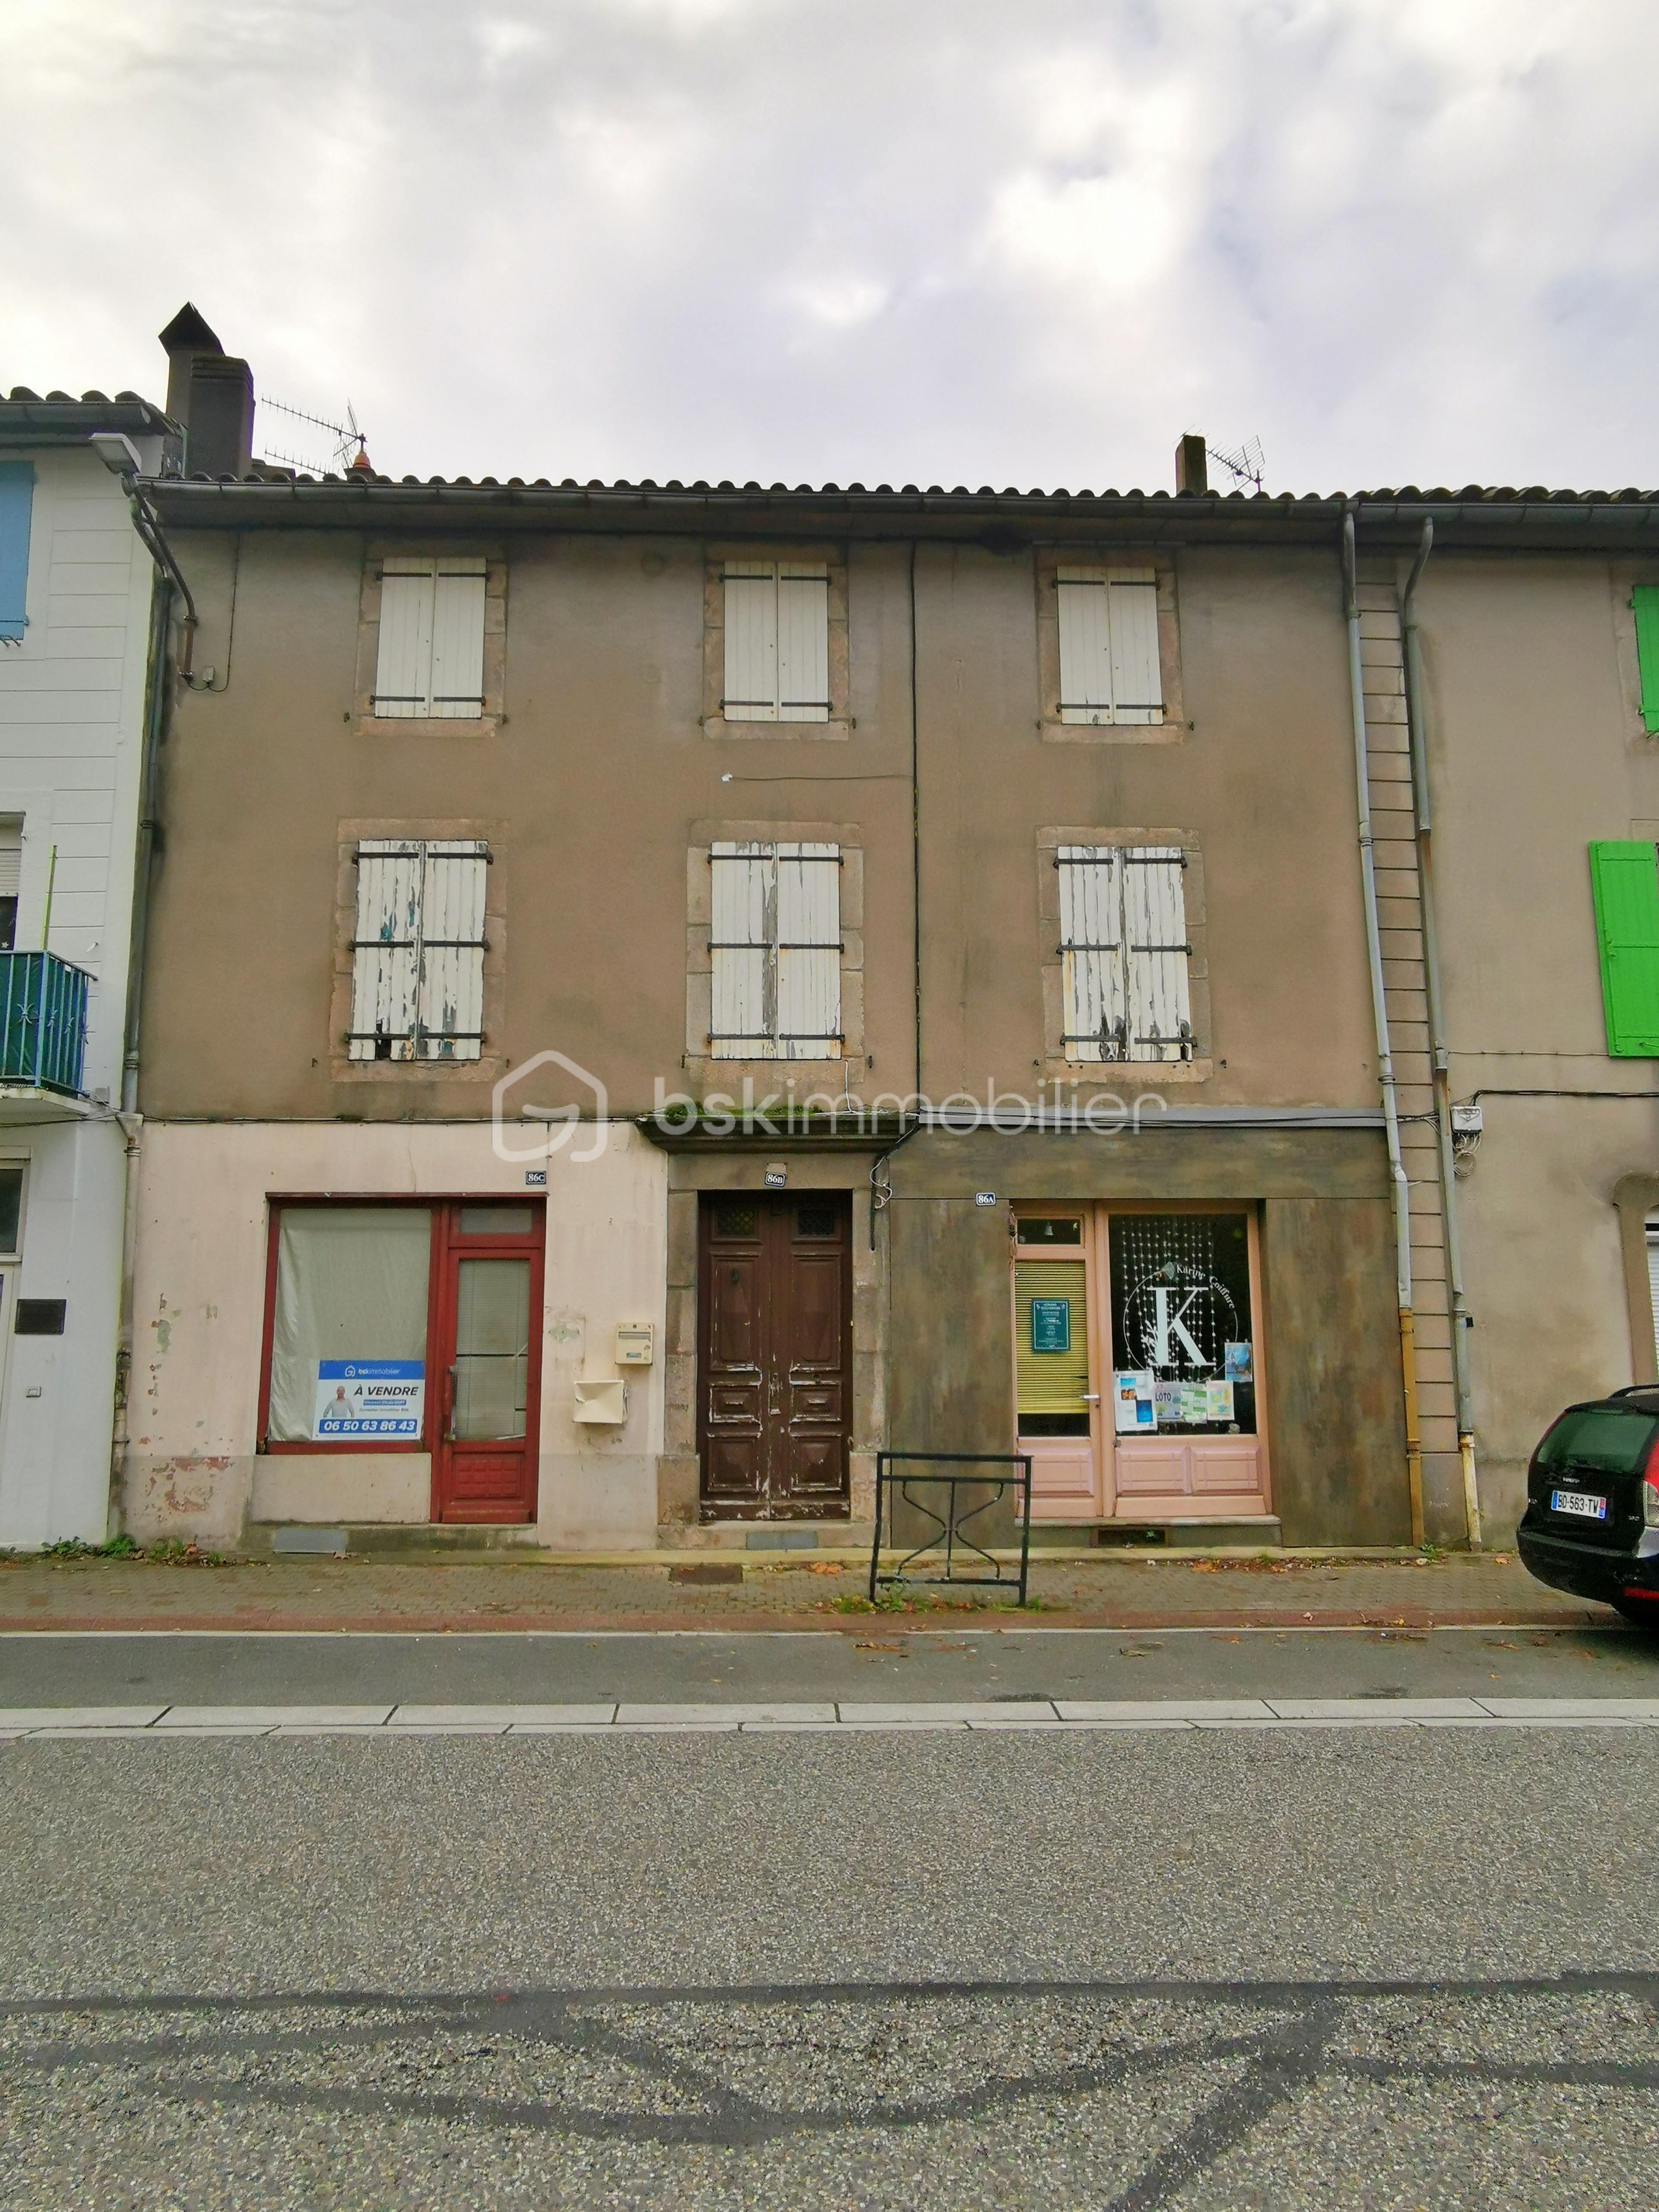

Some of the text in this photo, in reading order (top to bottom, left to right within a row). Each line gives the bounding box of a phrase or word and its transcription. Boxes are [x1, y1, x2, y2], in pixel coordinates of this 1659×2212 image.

[767, 1174, 783, 1184] 86B
[978, 1195, 994, 1204] 86A
[1176, 1264, 1235, 1309] Karine Coiffure
[1146, 1287, 1217, 1366] K
[353, 1384, 419, 1396] À VENDRE
[1155, 1392, 1171, 1402] LOTO
[324, 1421, 416, 1431] 06 50 63 86 43
